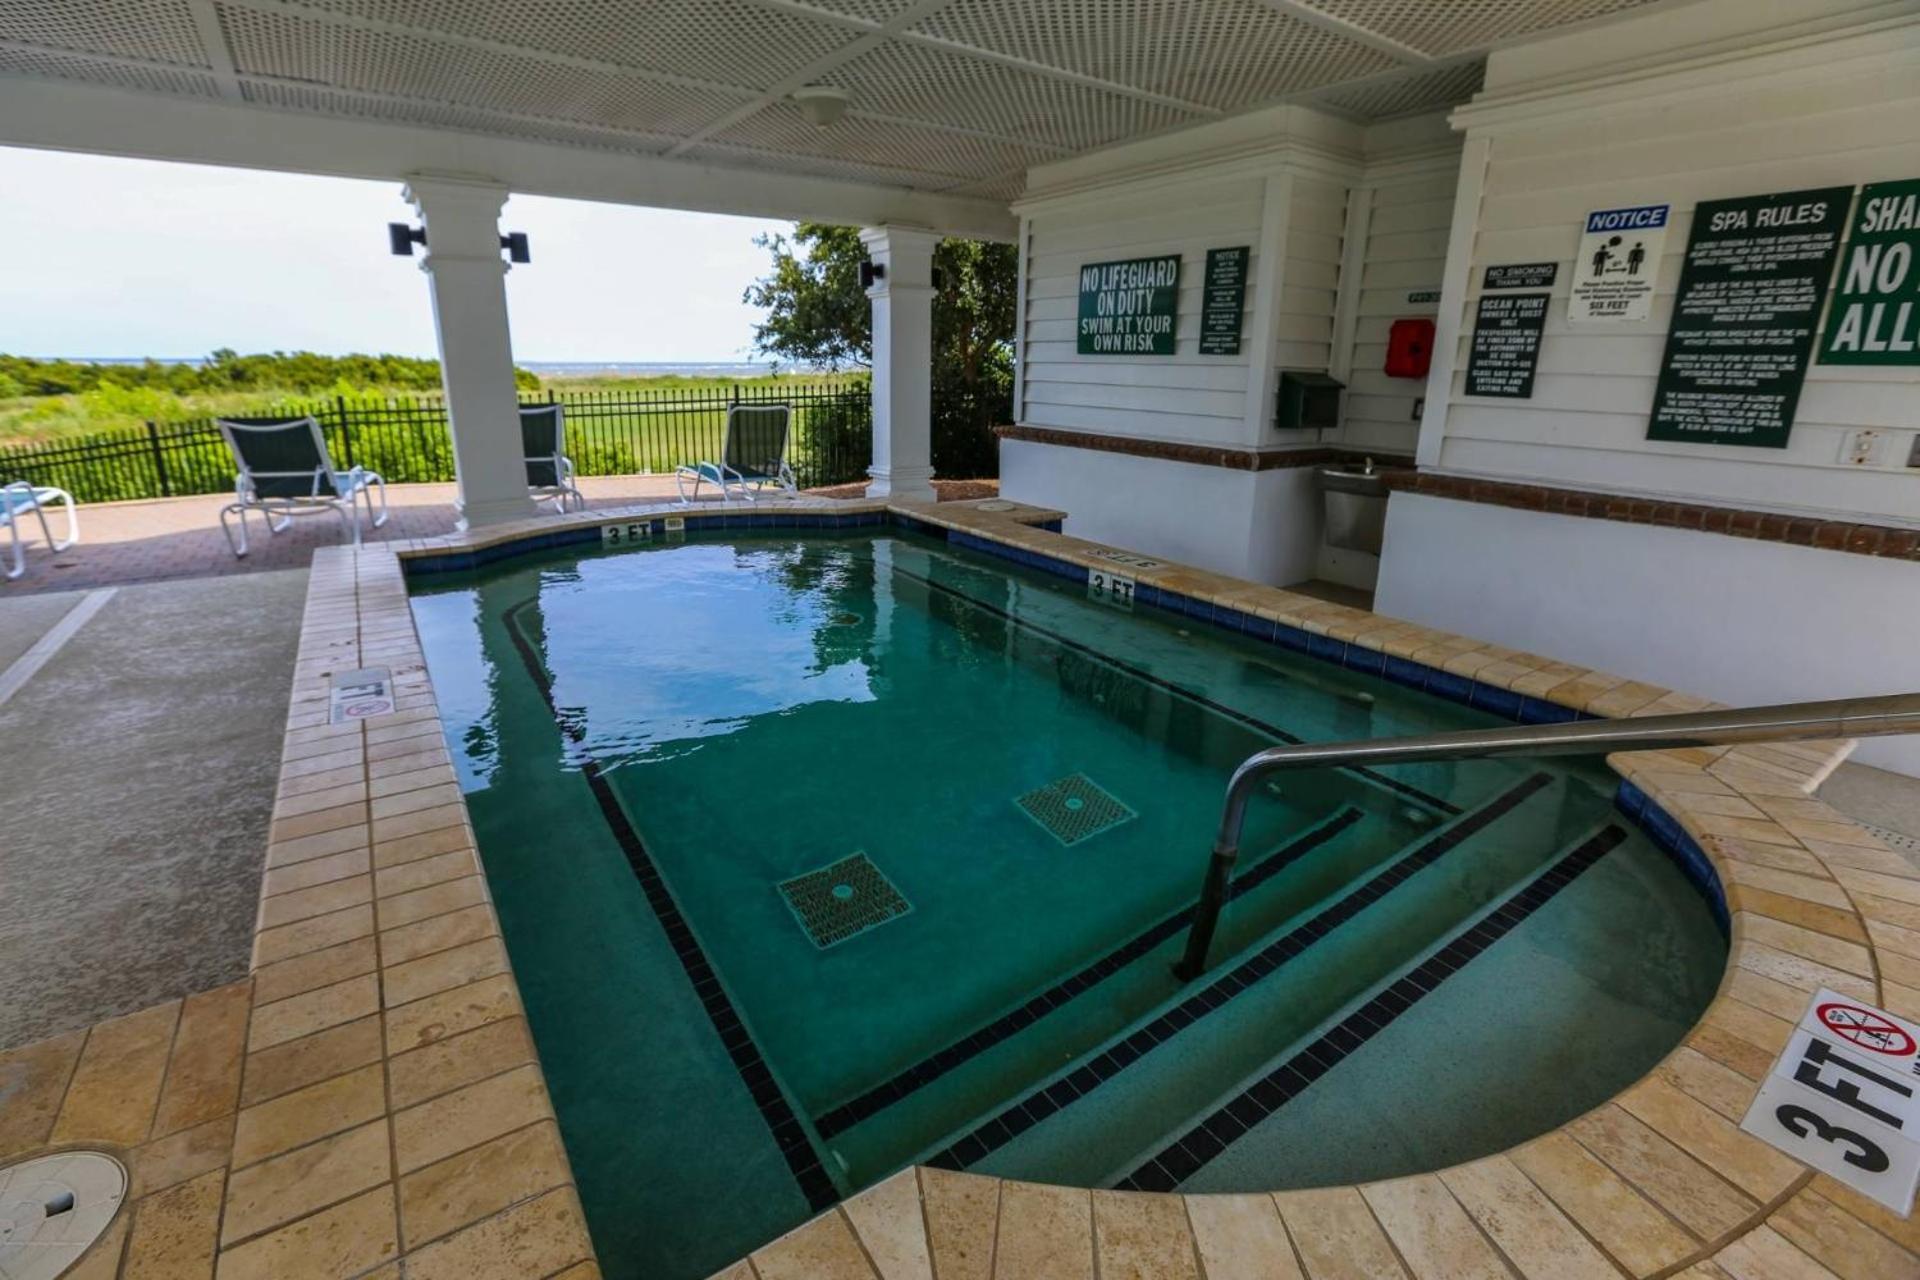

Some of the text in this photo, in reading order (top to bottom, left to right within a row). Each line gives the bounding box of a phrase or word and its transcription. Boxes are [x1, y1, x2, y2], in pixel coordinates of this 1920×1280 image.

[1590, 208, 1665, 229] NOTICE
[1710, 202, 1827, 231] SPA RULES
[1860, 194, 1920, 233] SHA
[1082, 260, 1176, 292] NO LIFEGUARD
[1489, 266, 1554, 277] NO SMOKING
[1843, 242, 1912, 294] NO
[1098, 288, 1154, 316] ON DUTY
[1516, 298, 1545, 308] POINT
[1590, 300, 1630, 310] SIX FEET
[1082, 315, 1171, 334] SWIM AT YOUR
[1830, 302, 1920, 351] ALL
[1094, 334, 1154, 350] OWN RISK
[1094, 575, 1132, 601] 3 FT
[1776, 1038, 1913, 1173] 3 FT
